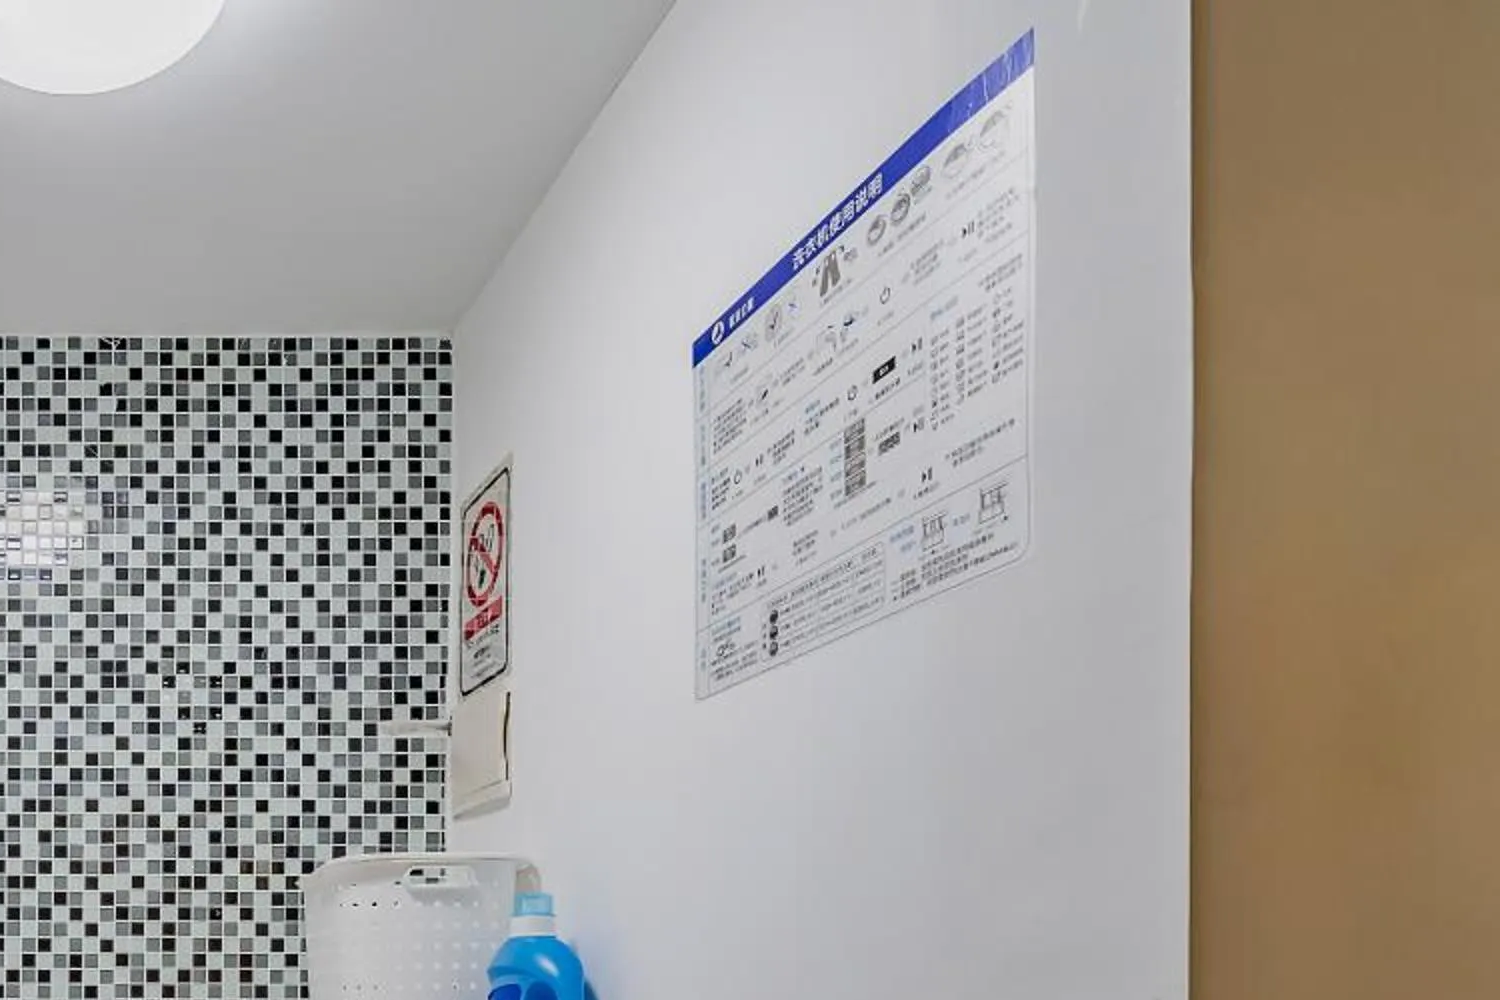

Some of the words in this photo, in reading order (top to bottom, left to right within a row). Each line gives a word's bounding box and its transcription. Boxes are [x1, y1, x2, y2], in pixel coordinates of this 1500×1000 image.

[792, 172, 883, 271] 洗衣机使用说明
